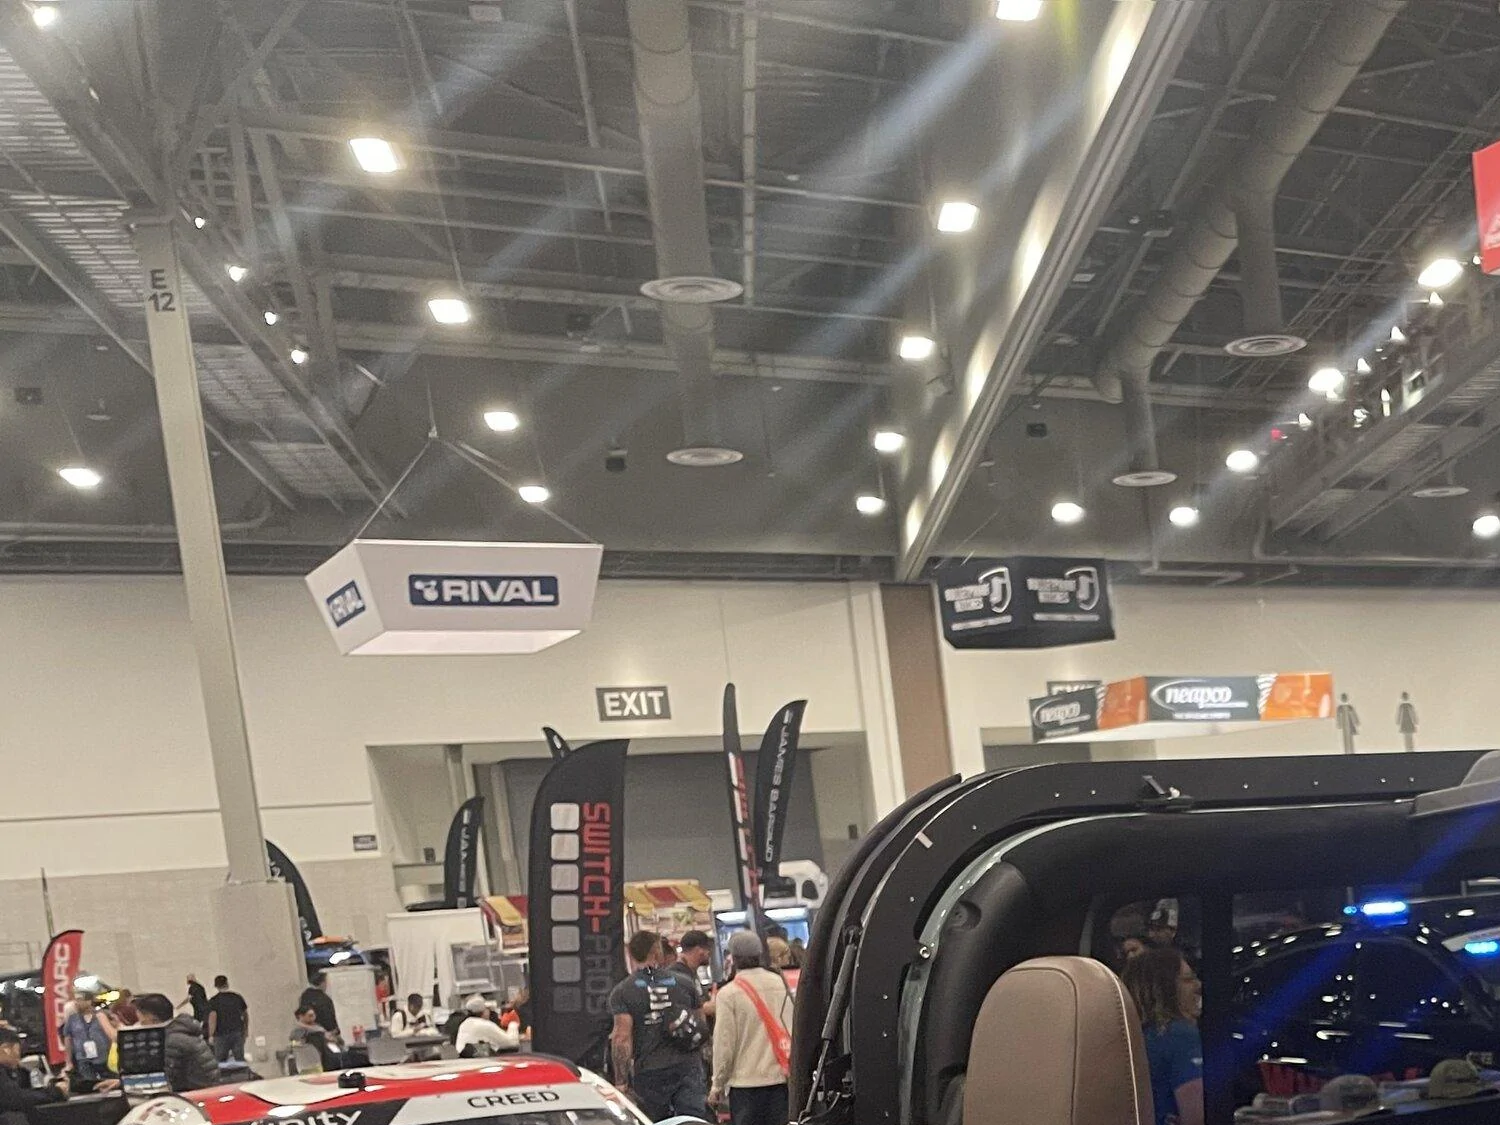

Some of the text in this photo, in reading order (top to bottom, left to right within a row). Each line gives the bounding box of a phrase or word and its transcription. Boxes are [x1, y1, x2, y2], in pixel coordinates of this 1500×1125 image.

[150, 268, 167, 289] E
[148, 291, 176, 312] 12
[443, 579, 555, 603] RIVAL
[604, 691, 664, 717] EXIT
[1165, 686, 1232, 709] neapco
[467, 1090, 561, 1110] CREED
